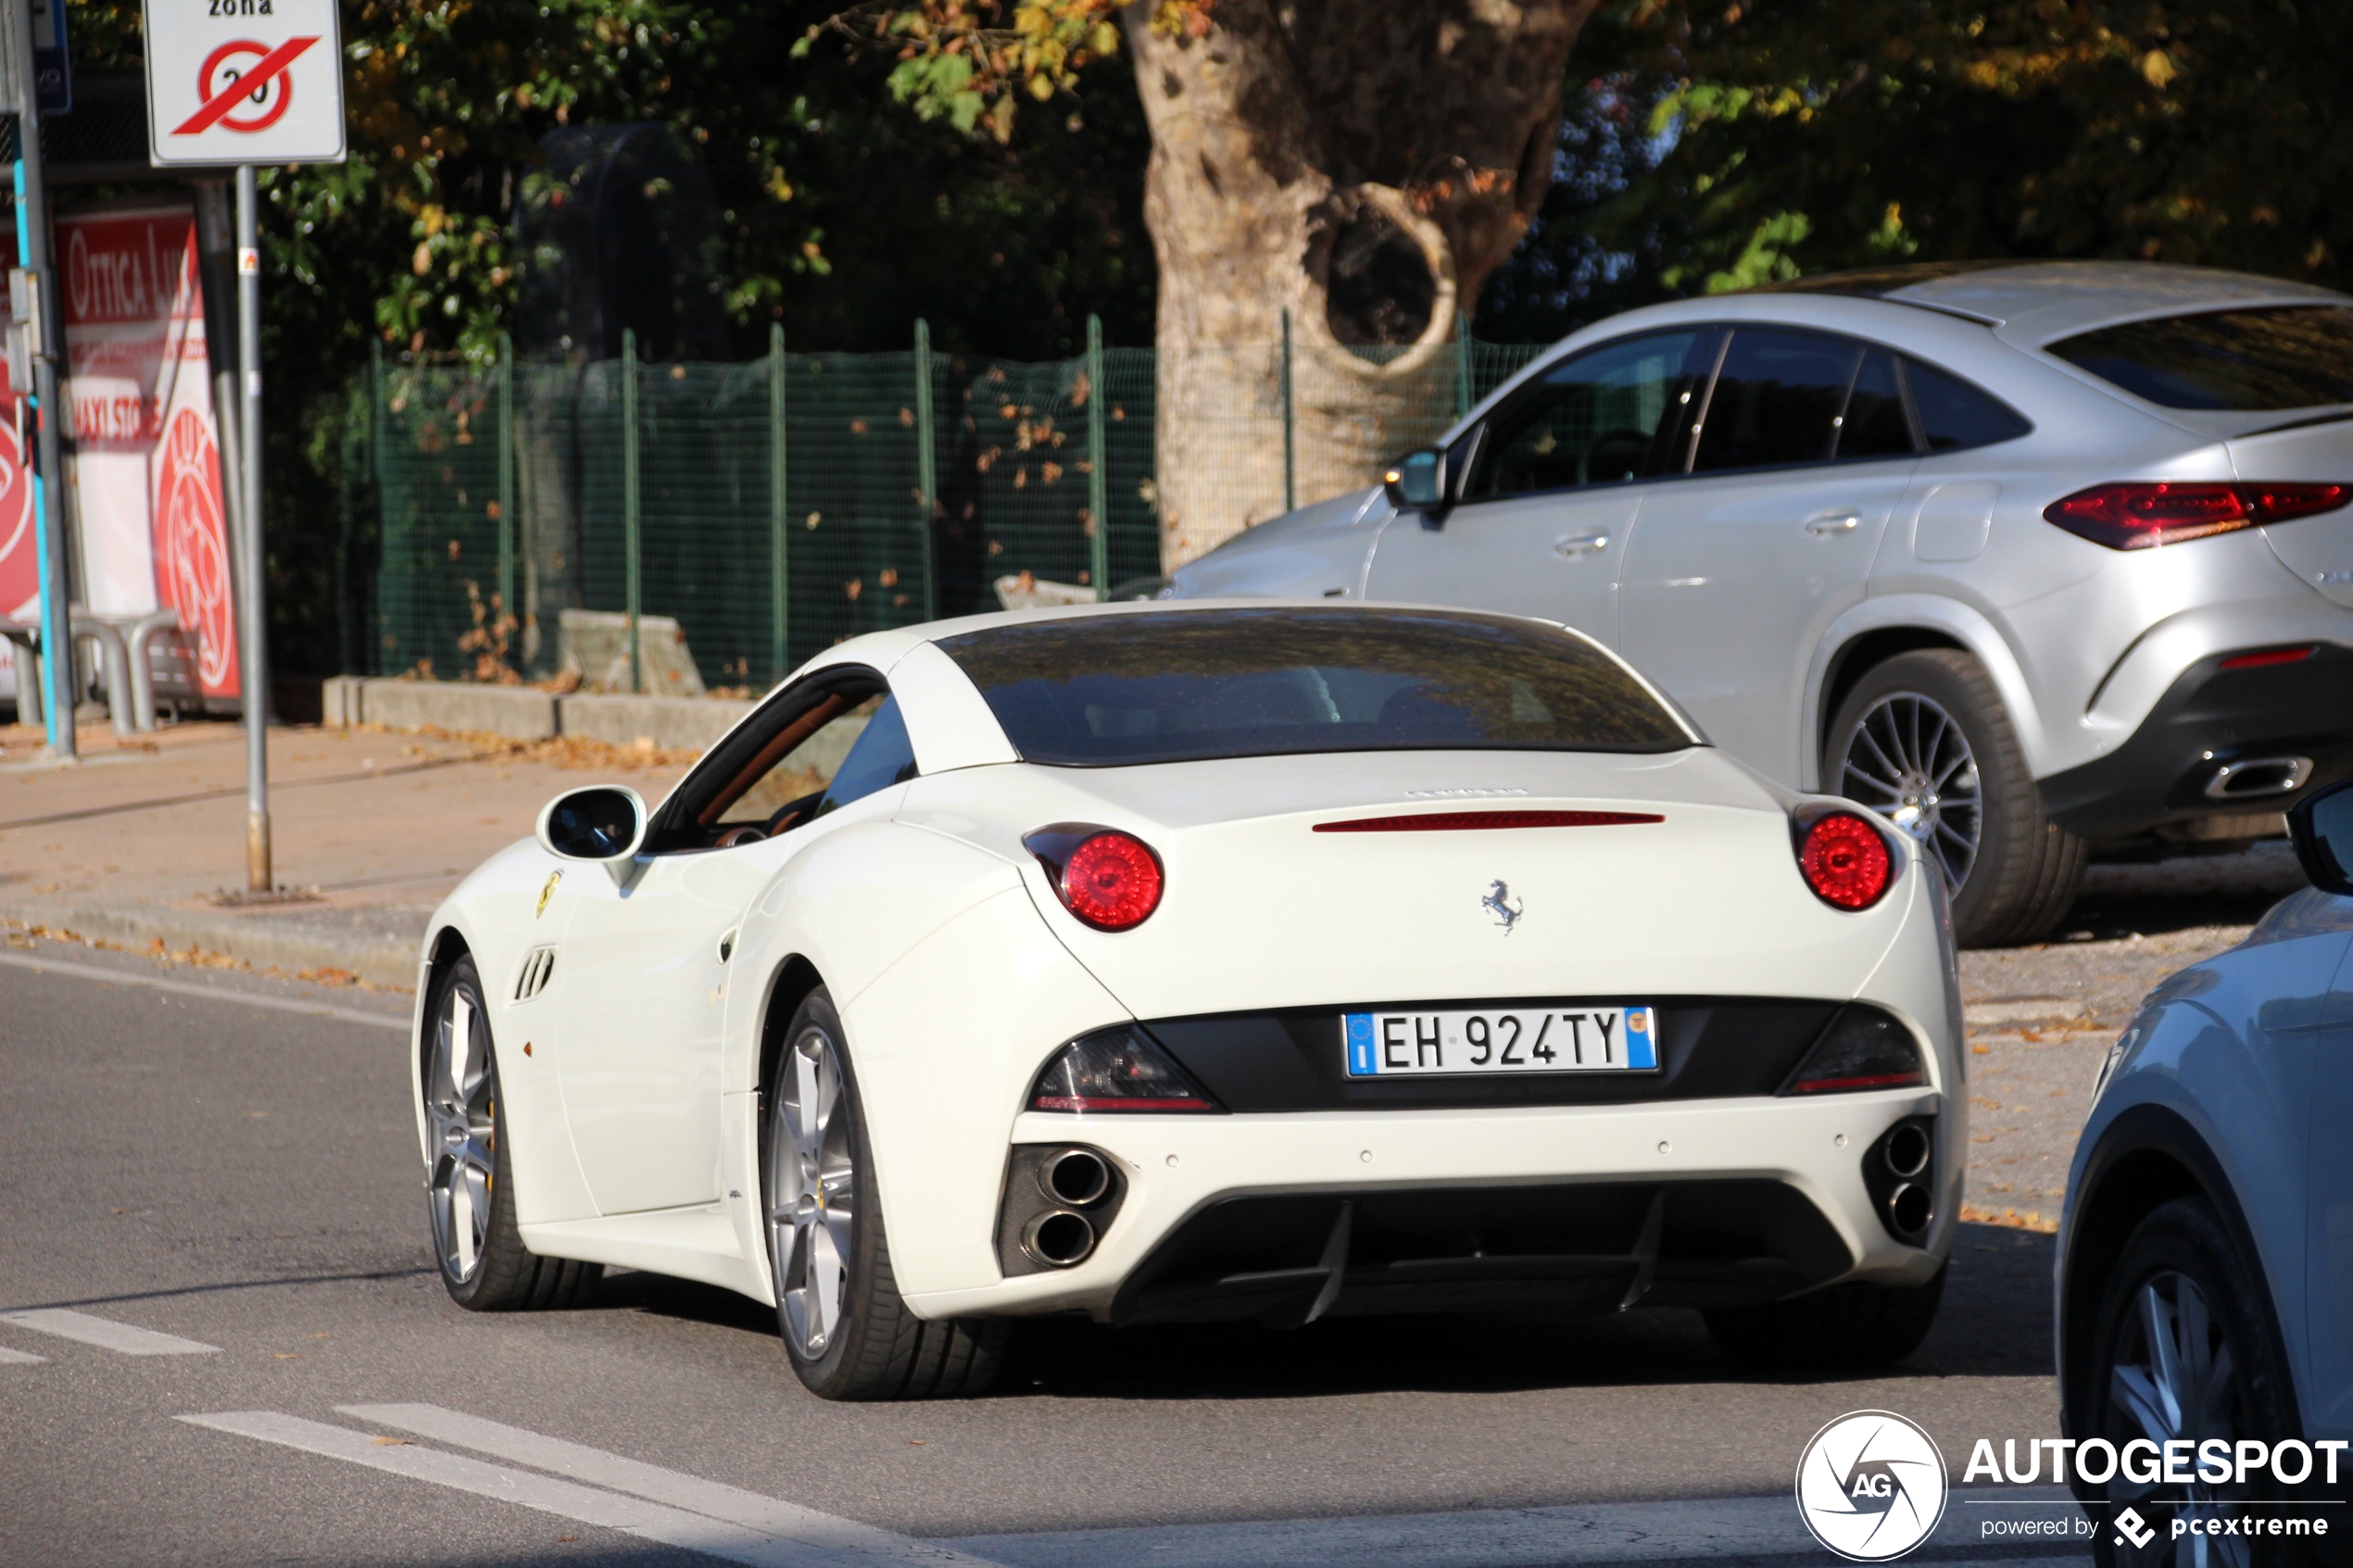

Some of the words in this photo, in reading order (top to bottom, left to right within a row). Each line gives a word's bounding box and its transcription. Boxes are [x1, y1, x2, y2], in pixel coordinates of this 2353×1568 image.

[209, 0, 273, 16] zona
[1381, 1017, 1443, 1068] EH
[1466, 1013, 1617, 1065] 924TY
